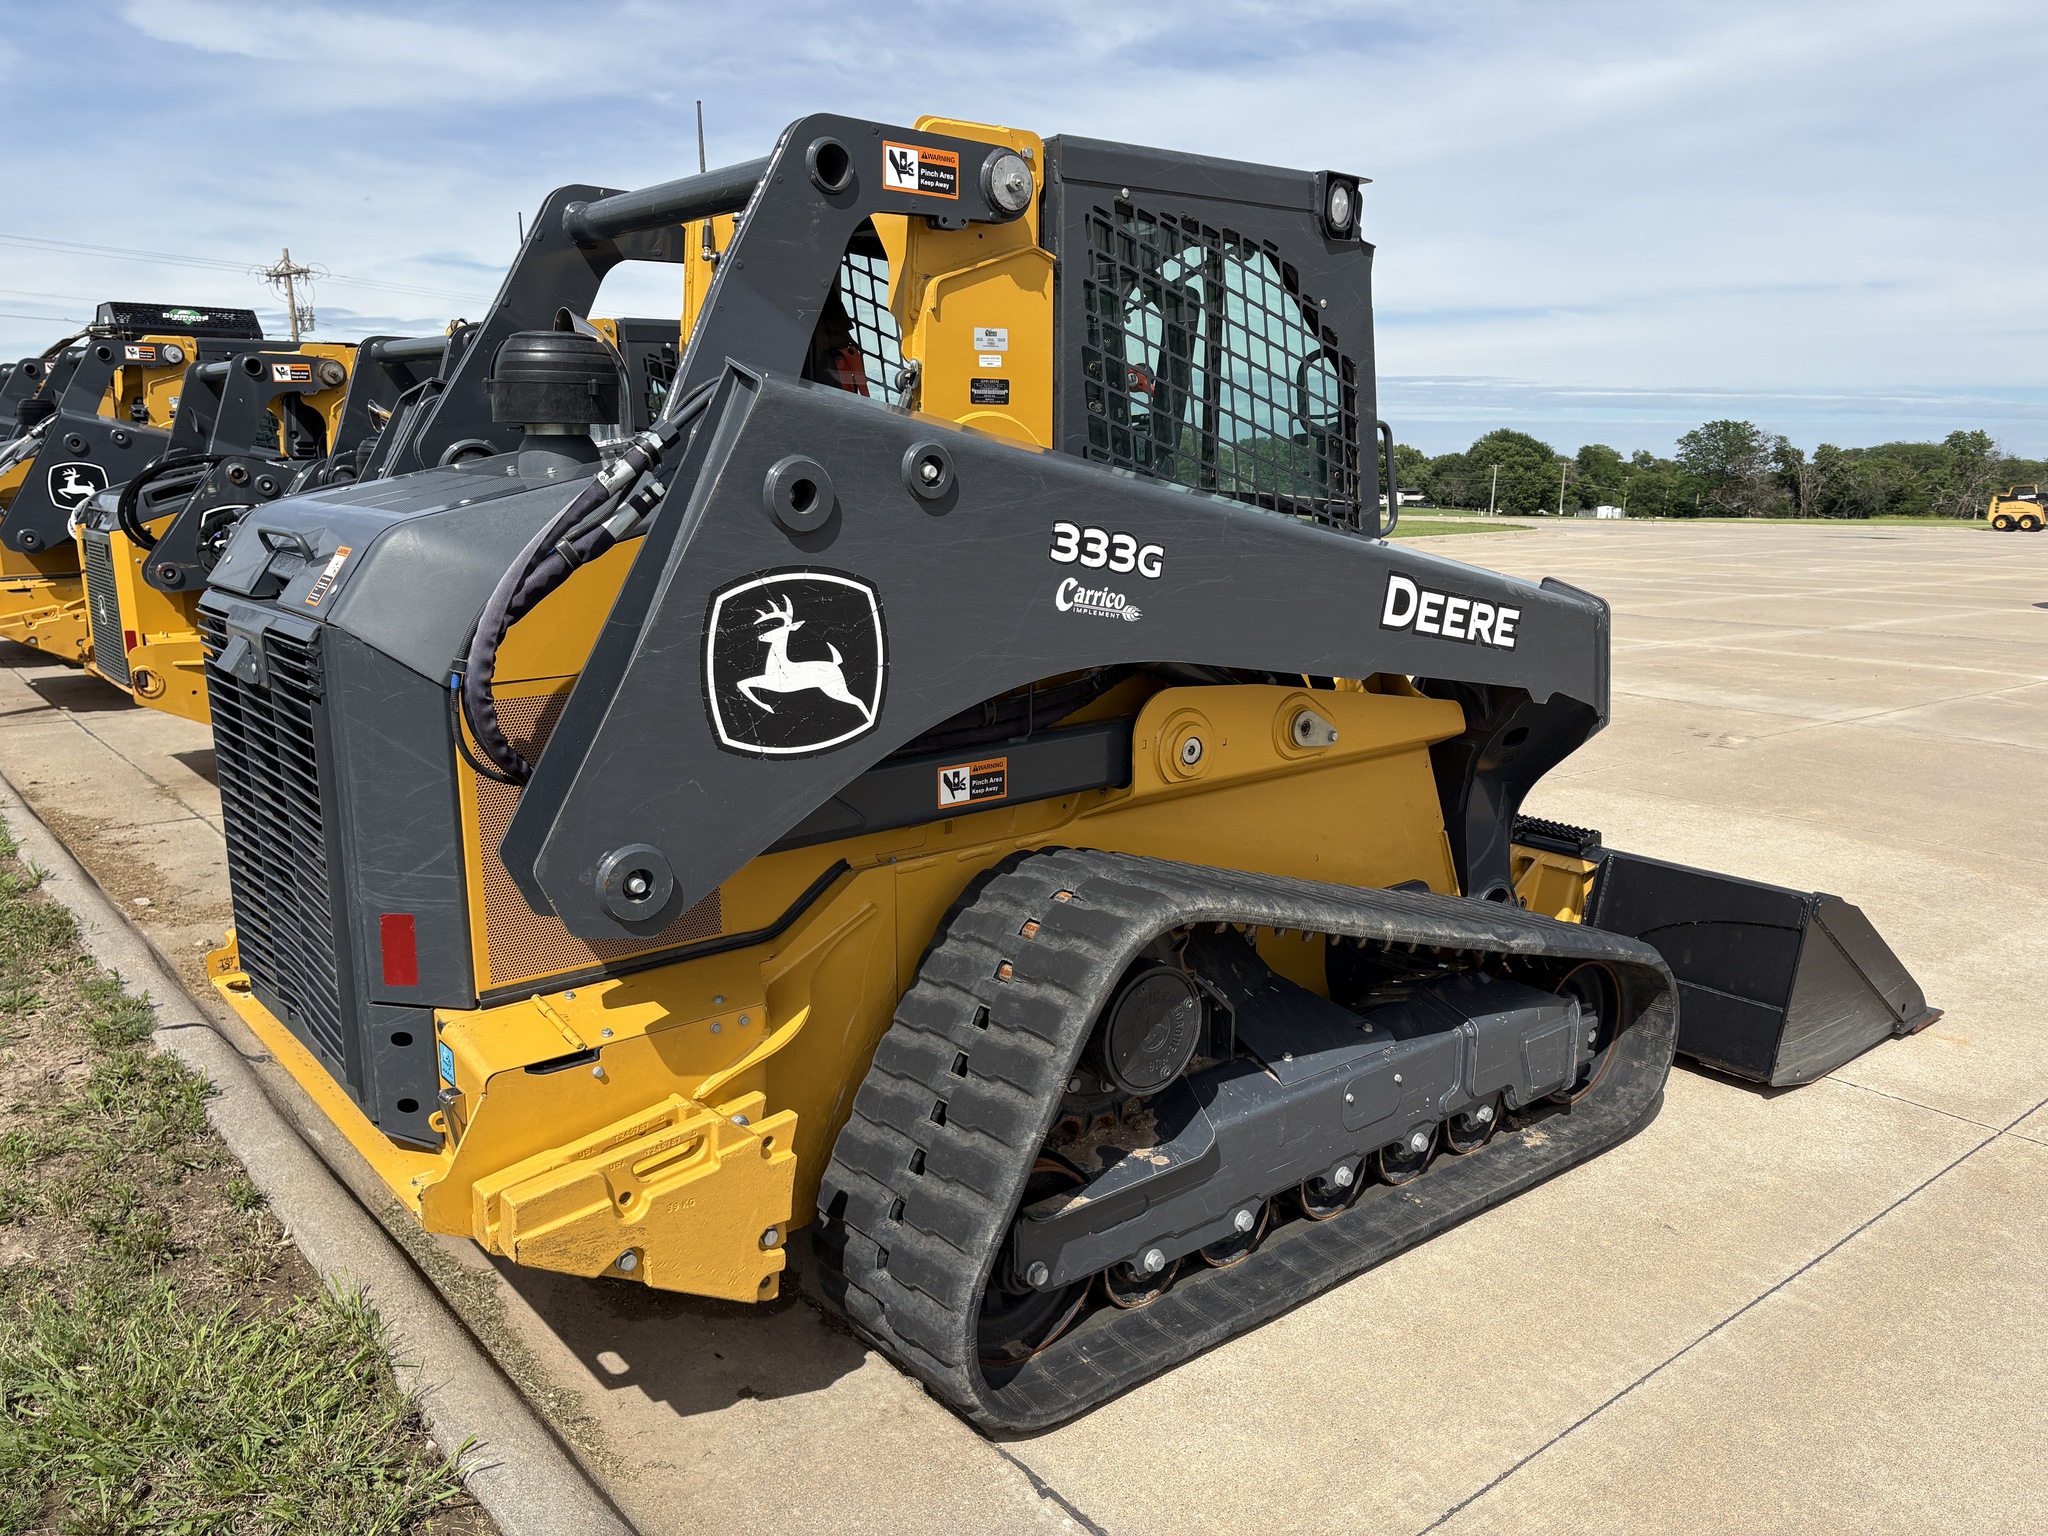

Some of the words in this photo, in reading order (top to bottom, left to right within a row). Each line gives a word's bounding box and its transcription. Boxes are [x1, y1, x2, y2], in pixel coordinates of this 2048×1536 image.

[926, 153, 956, 164] WARNING
[920, 168, 939, 178] Pinch
[939, 171, 954, 181] Area
[920, 179, 935, 188] Keep
[935, 181, 950, 190] Away
[1050, 521, 1165, 579] 333G
[1055, 577, 1126, 612] Carrico
[1073, 606, 1121, 619] IMPLEMENT
[1382, 574, 1521, 648] DEERE
[977, 761, 1004, 772] WARNING
[972, 777, 989, 786] Pinch
[989, 776, 1003, 784] Area
[972, 786, 985, 794] Keep
[985, 785, 998, 793] Away
[578, 1146, 597, 1159] USA
[609, 1158, 628, 1171] USA
[666, 1202, 680, 1213] 39
[682, 1197, 696, 1209] KG
